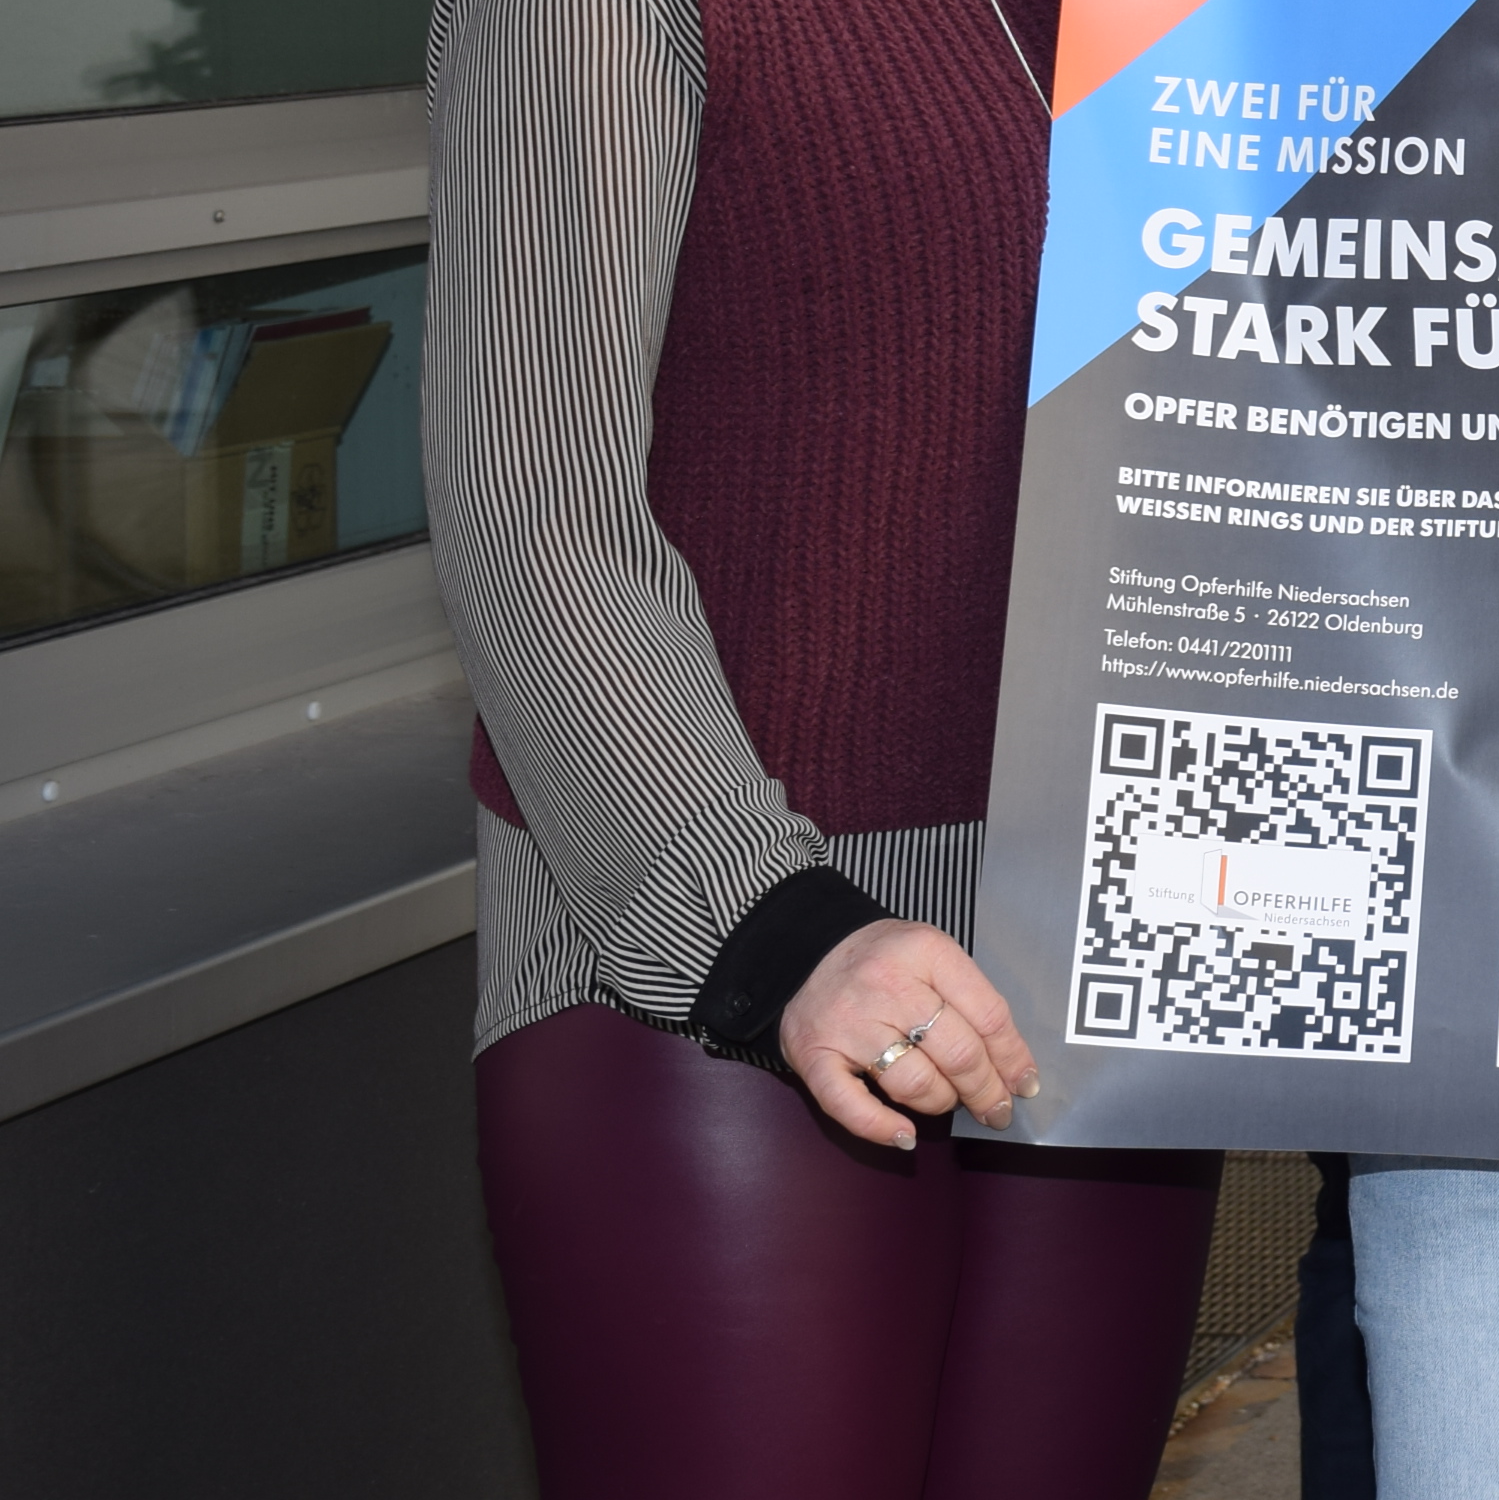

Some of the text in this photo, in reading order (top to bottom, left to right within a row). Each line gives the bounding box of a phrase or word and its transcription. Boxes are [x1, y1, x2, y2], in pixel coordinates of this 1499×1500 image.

[1151, 76, 1375, 122] ZWEI FÜR
[1149, 127, 1465, 175] EINE MISSION
[1132, 292, 1391, 366] STARK
[1125, 393, 1237, 429] OPFER
[1247, 404, 1450, 439] BENÖTIGEN
[1119, 467, 1180, 490] BITTE
[1186, 474, 1350, 504] INFORMIEREN
[1356, 488, 1390, 506] SIE
[1397, 485, 1456, 507] ÜBER
[1116, 495, 1221, 523] WEISSEN
[1228, 507, 1303, 530] RINGS
[1310, 514, 1364, 534] UND
[1370, 518, 1414, 536] DER
[1109, 567, 1409, 607] Stiftung Opferhilfe Niedersachsen
[1107, 594, 1229, 621] Mühlenstraße
[1234, 607, 1245, 622] 5
[1267, 609, 1319, 629] 26122
[1325, 614, 1423, 639] Oldenburg
[1104, 629, 1291, 662] Telefon: 0441/2201111
[1102, 655, 1458, 699] https://www.opferhilfe.niedersachsen.de
[1148, 887, 1195, 904] Stiftung
[1233, 890, 1353, 913] OPFERHILFE
[1264, 912, 1351, 928] Niedersachsen
